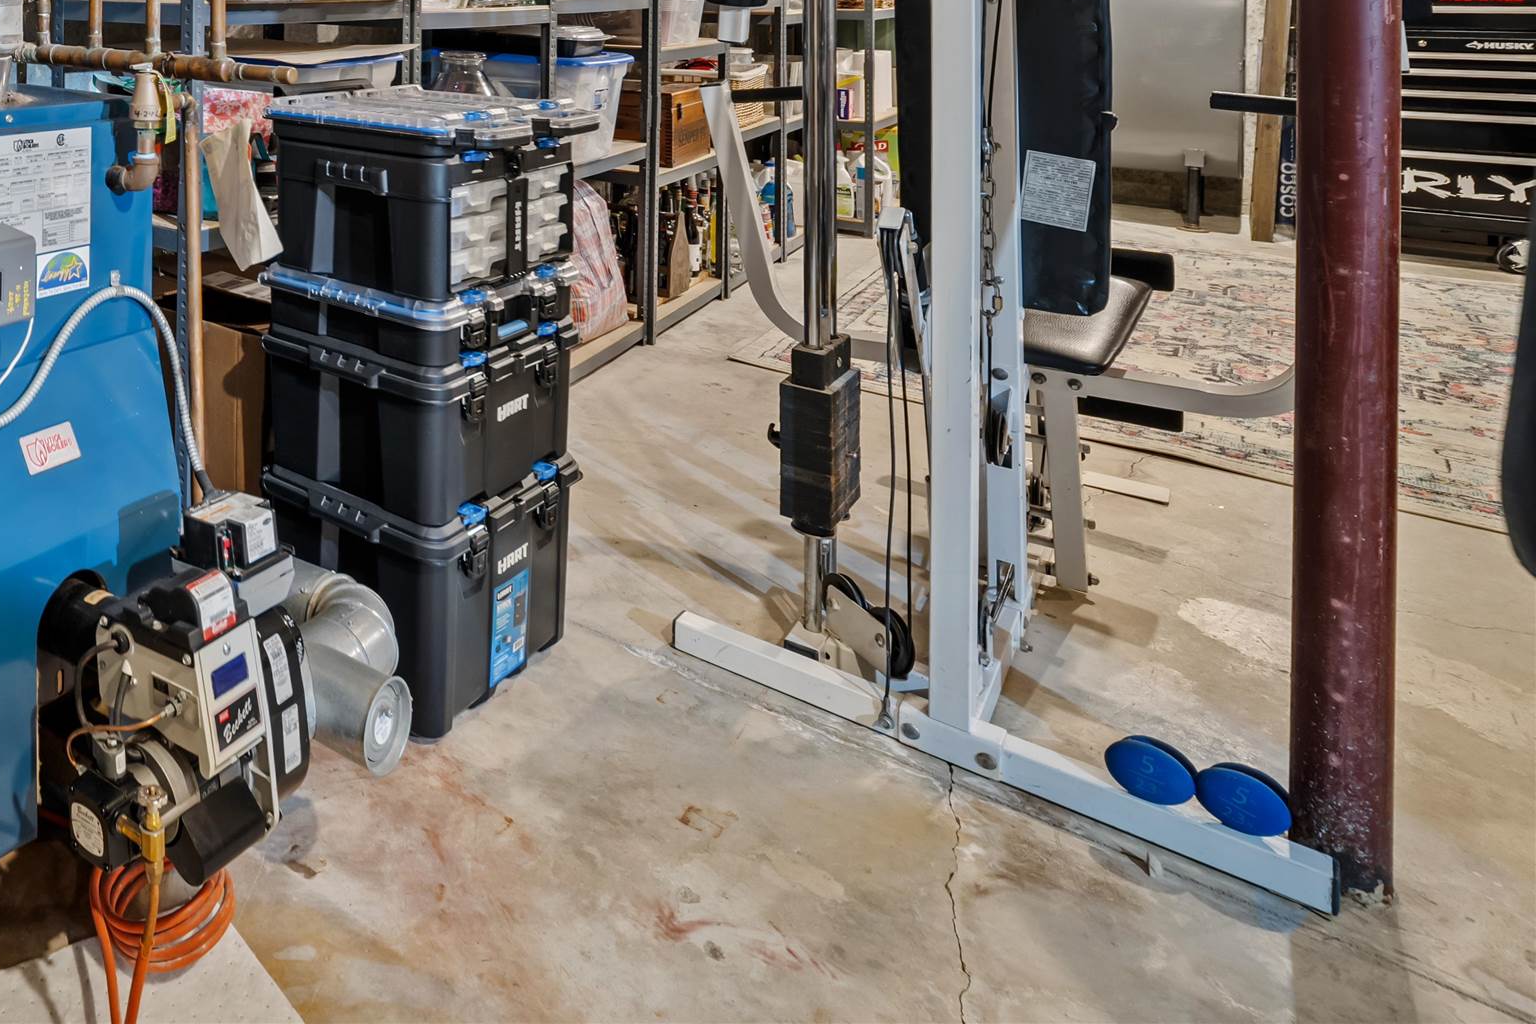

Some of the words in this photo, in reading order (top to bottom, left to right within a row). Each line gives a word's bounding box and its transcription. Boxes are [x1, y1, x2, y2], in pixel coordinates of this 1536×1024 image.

[1483, 41, 1535, 50] HUSKY
[1279, 162, 1293, 218] COSCO
[1401, 166, 1536, 204] RLY
[513, 201, 523, 253] HART
[496, 393, 529, 423] HART
[496, 541, 529, 575] HART
